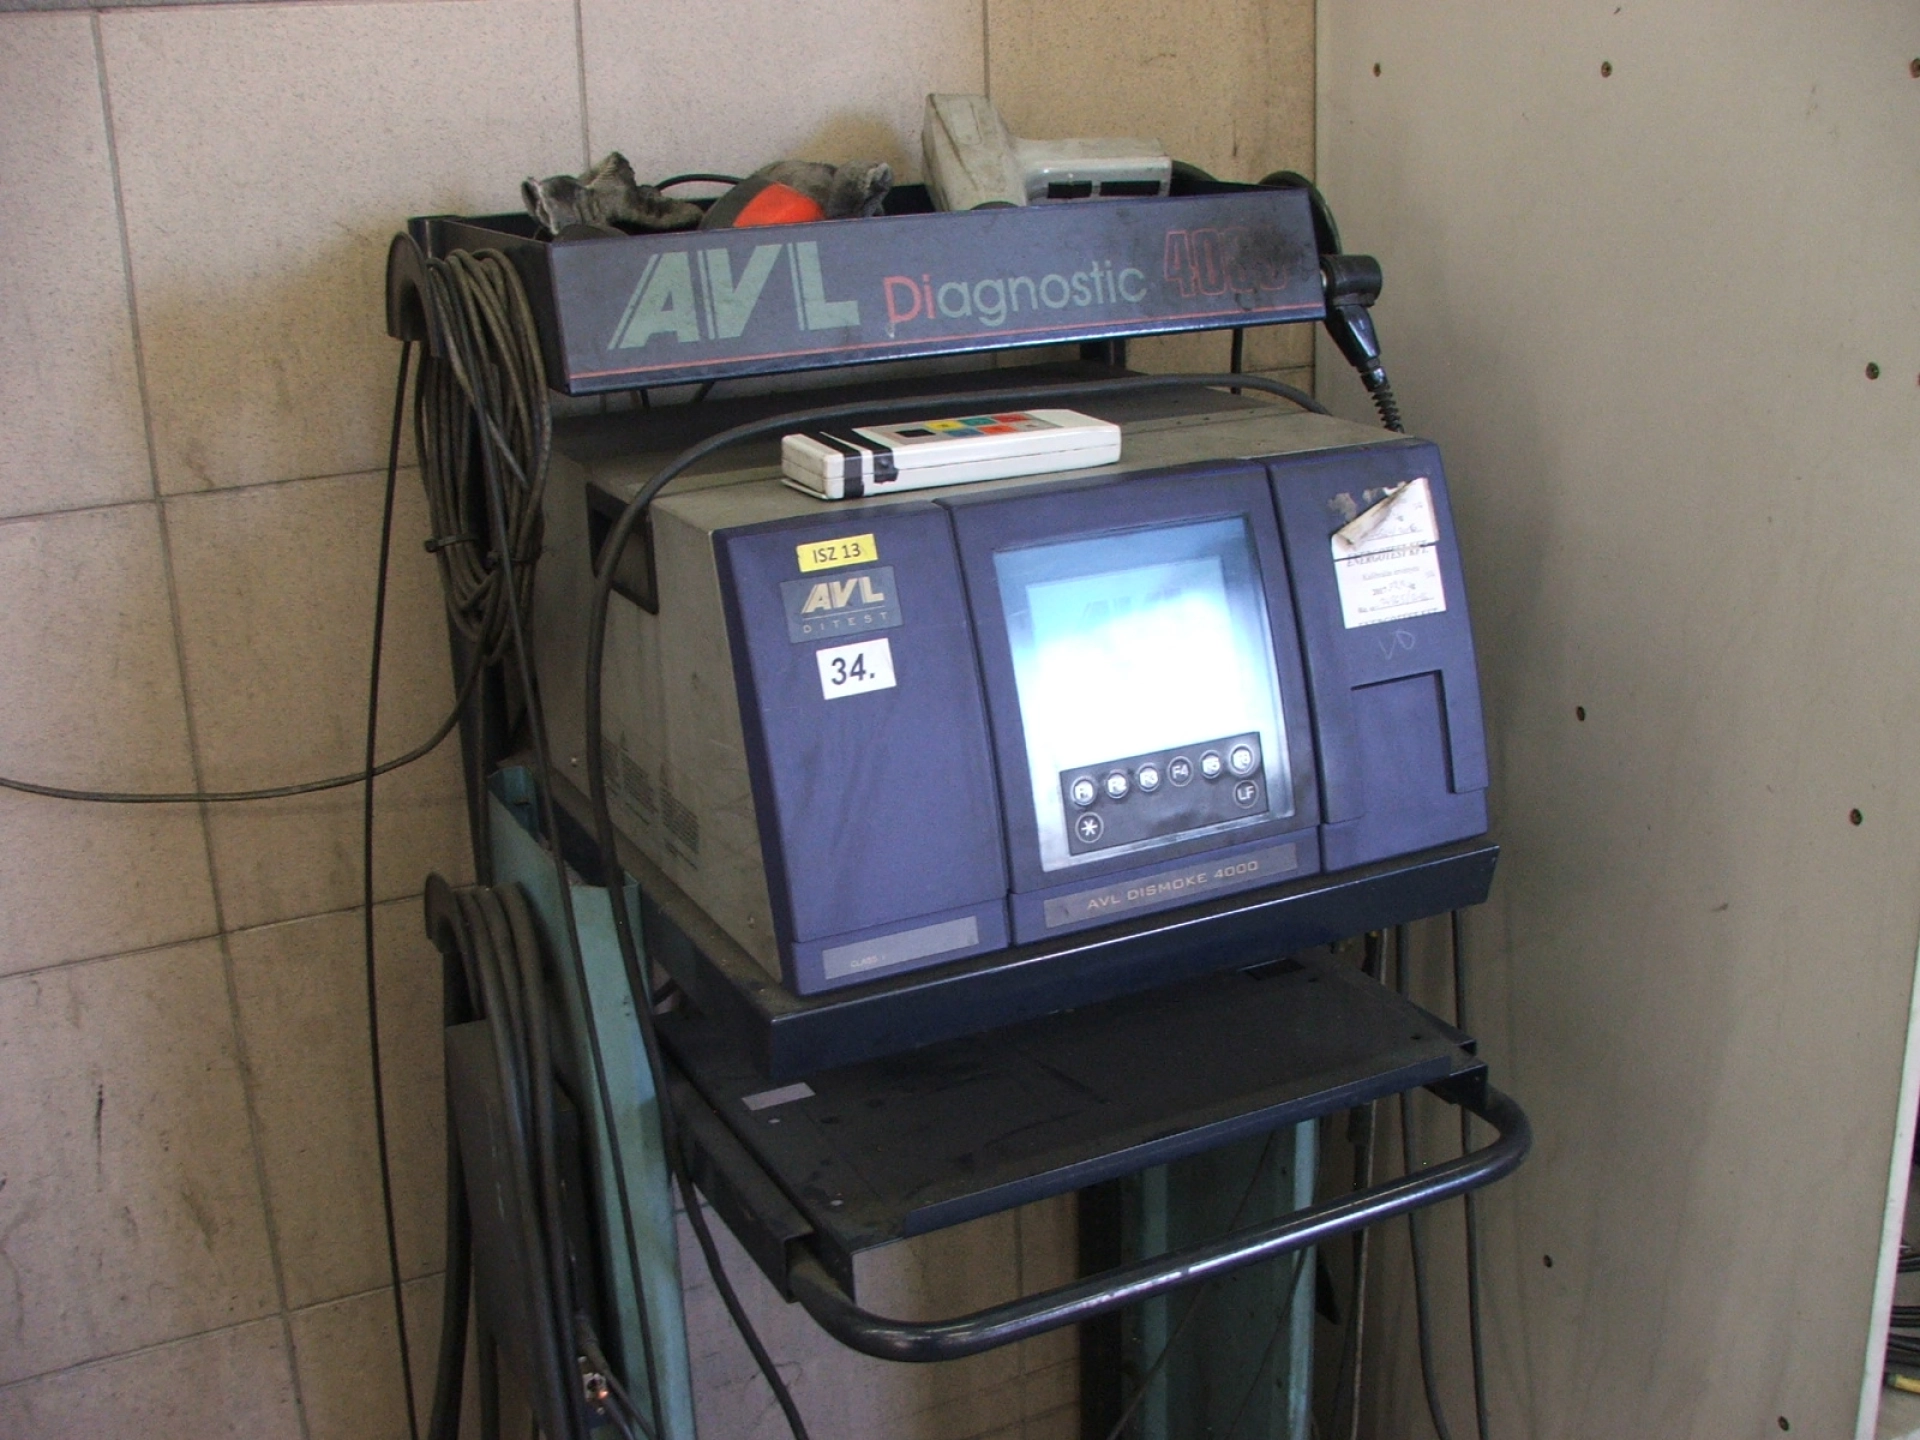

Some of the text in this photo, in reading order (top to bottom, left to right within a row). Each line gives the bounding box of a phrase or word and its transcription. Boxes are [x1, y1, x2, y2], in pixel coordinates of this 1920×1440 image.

[607, 240, 861, 351] AVL
[884, 258, 1148, 327] Diagnostic
[813, 542, 862, 564] ISZ 13
[801, 576, 885, 614] AVL
[803, 611, 888, 633] DITEST
[831, 653, 876, 685] 34.
[1172, 764, 1188, 779] F4
[1237, 786, 1254, 800] LF
[1087, 860, 1259, 910] AVL DISMOKE 4000
